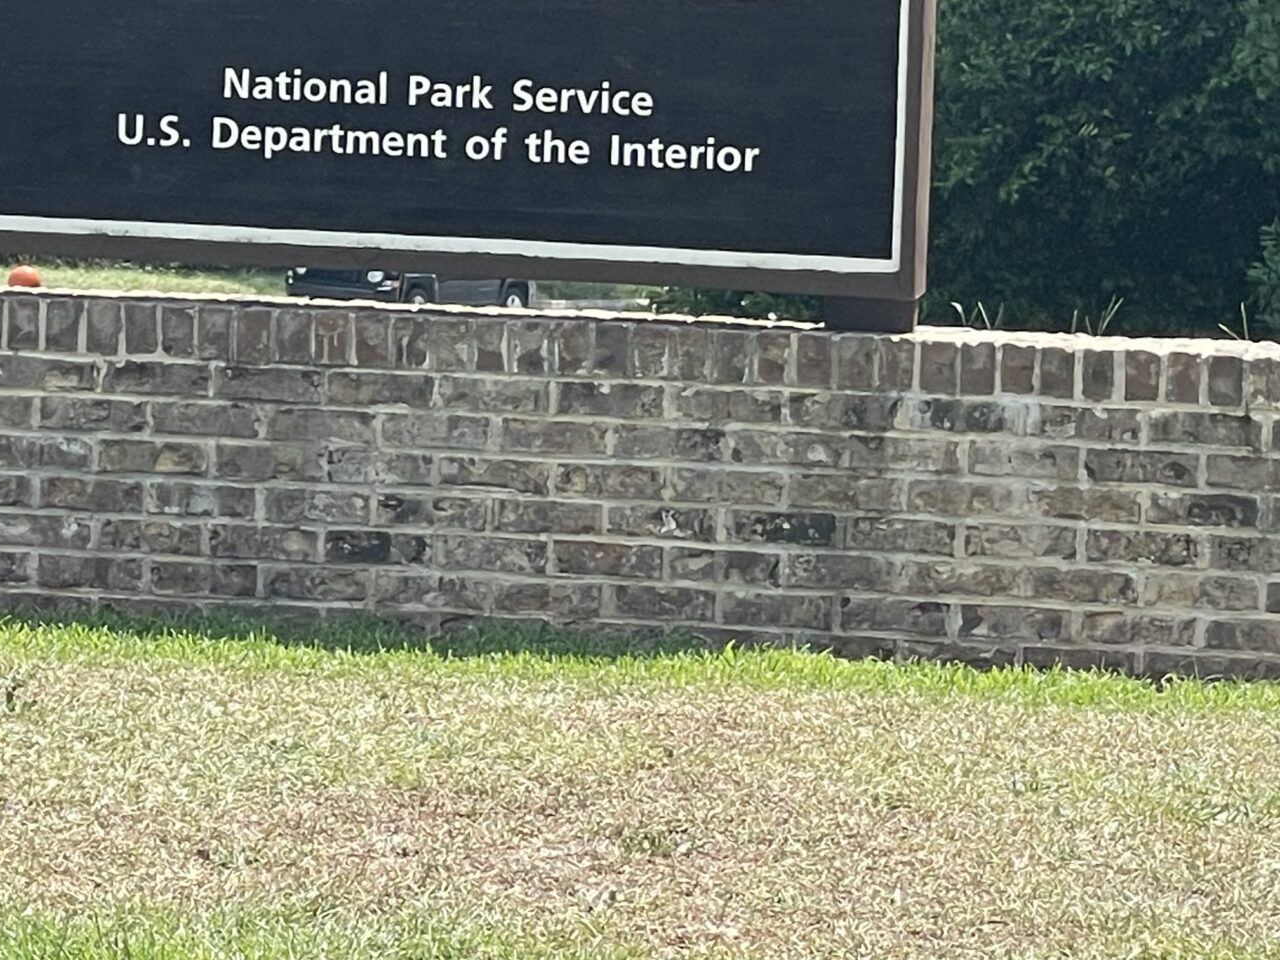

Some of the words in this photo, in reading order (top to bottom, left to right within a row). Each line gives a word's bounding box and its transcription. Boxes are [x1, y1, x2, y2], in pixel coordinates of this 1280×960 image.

[223, 67, 388, 105] National
[408, 75, 494, 109] Park
[513, 78, 654, 116] Service
[118, 113, 191, 147] U.S.
[212, 116, 447, 159] Department
[465, 127, 508, 161] of
[524, 129, 590, 165] the
[610, 134, 760, 172] Interior
